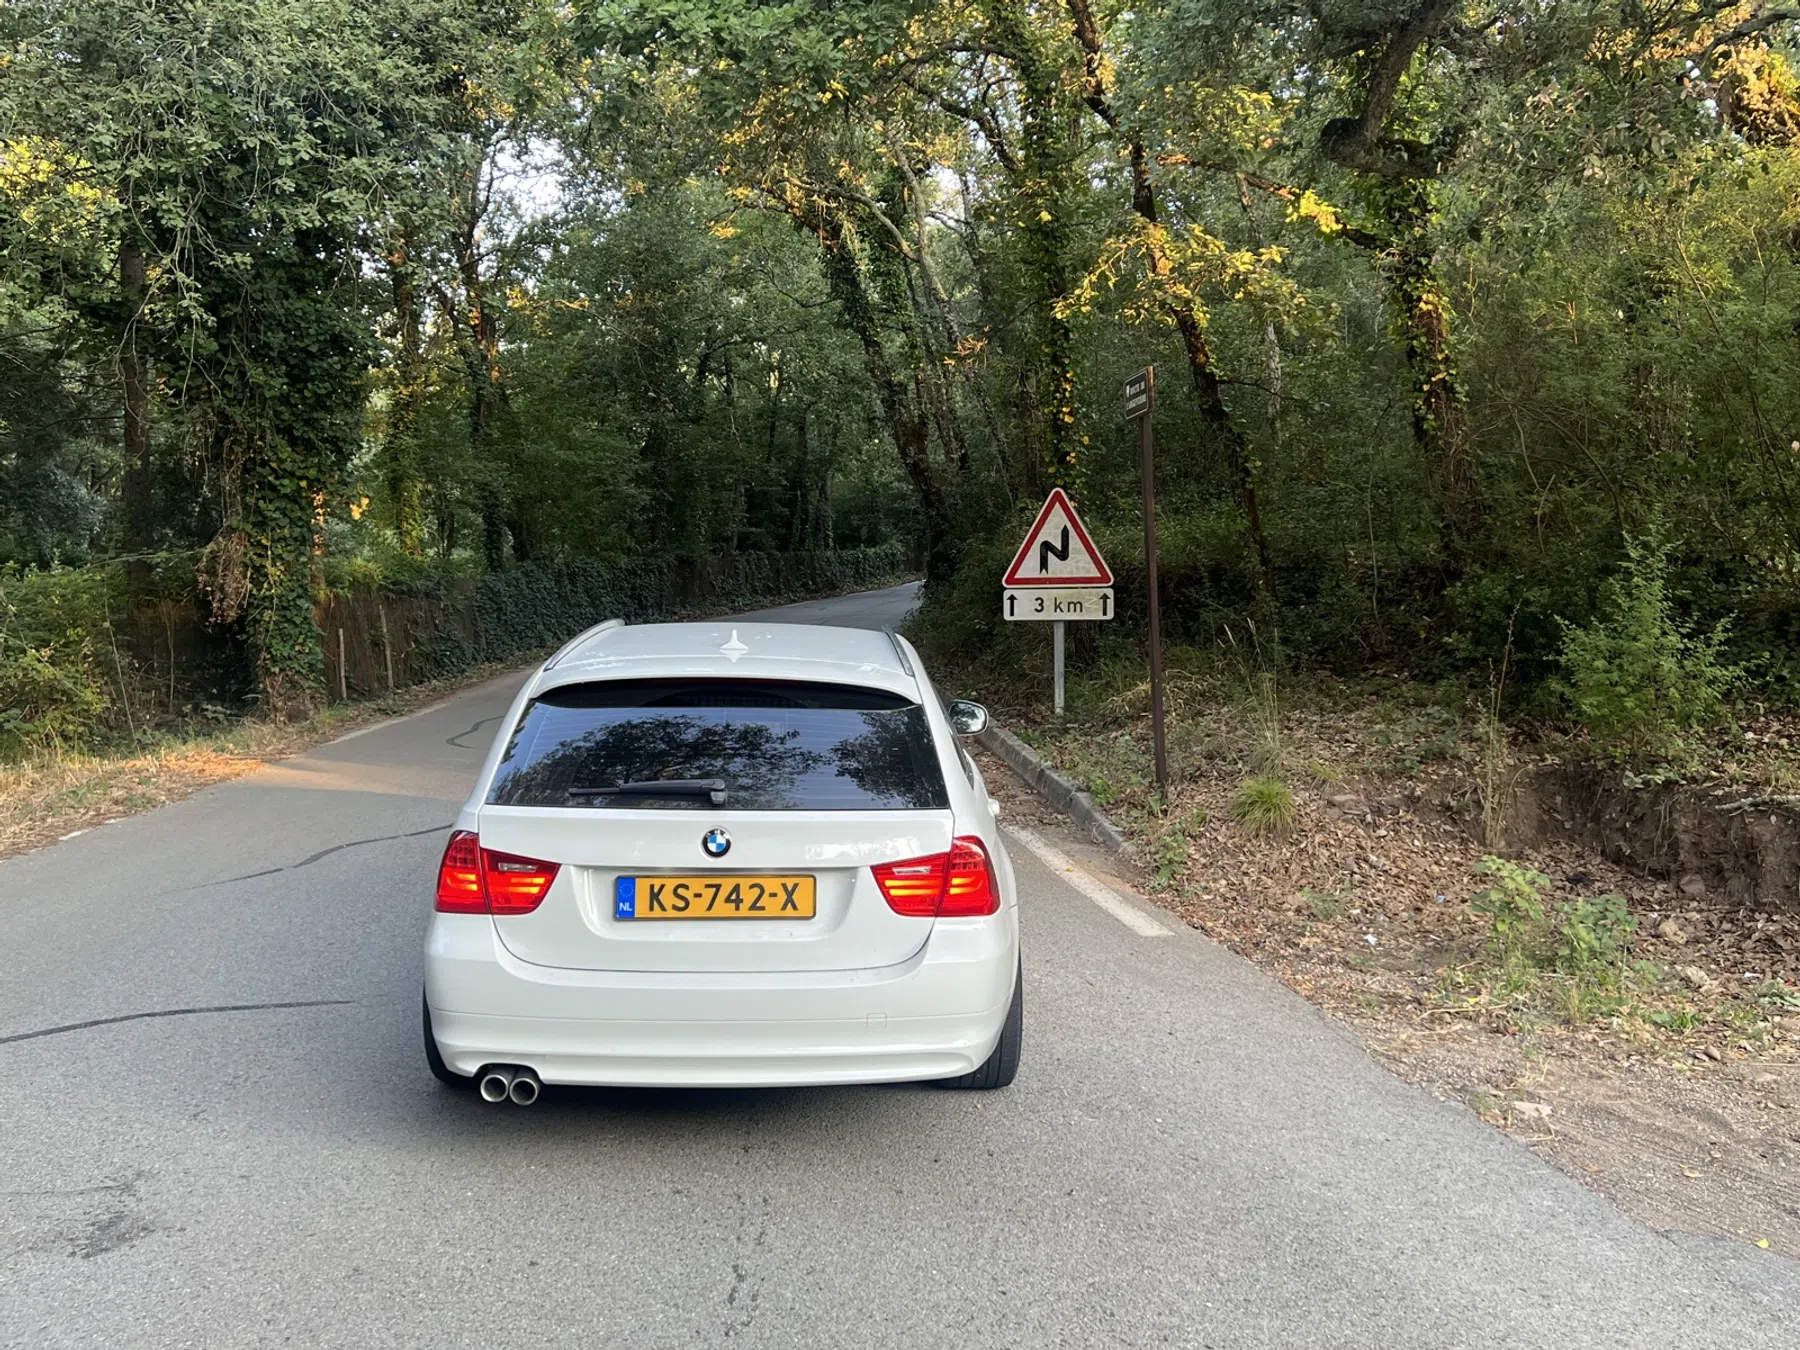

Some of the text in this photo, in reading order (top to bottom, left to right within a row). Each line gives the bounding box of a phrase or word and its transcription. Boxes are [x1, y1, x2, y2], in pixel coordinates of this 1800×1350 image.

[1034, 597, 1083, 613] 3 km
[648, 883, 800, 912] KS-742-X
[619, 902, 633, 912] NL
